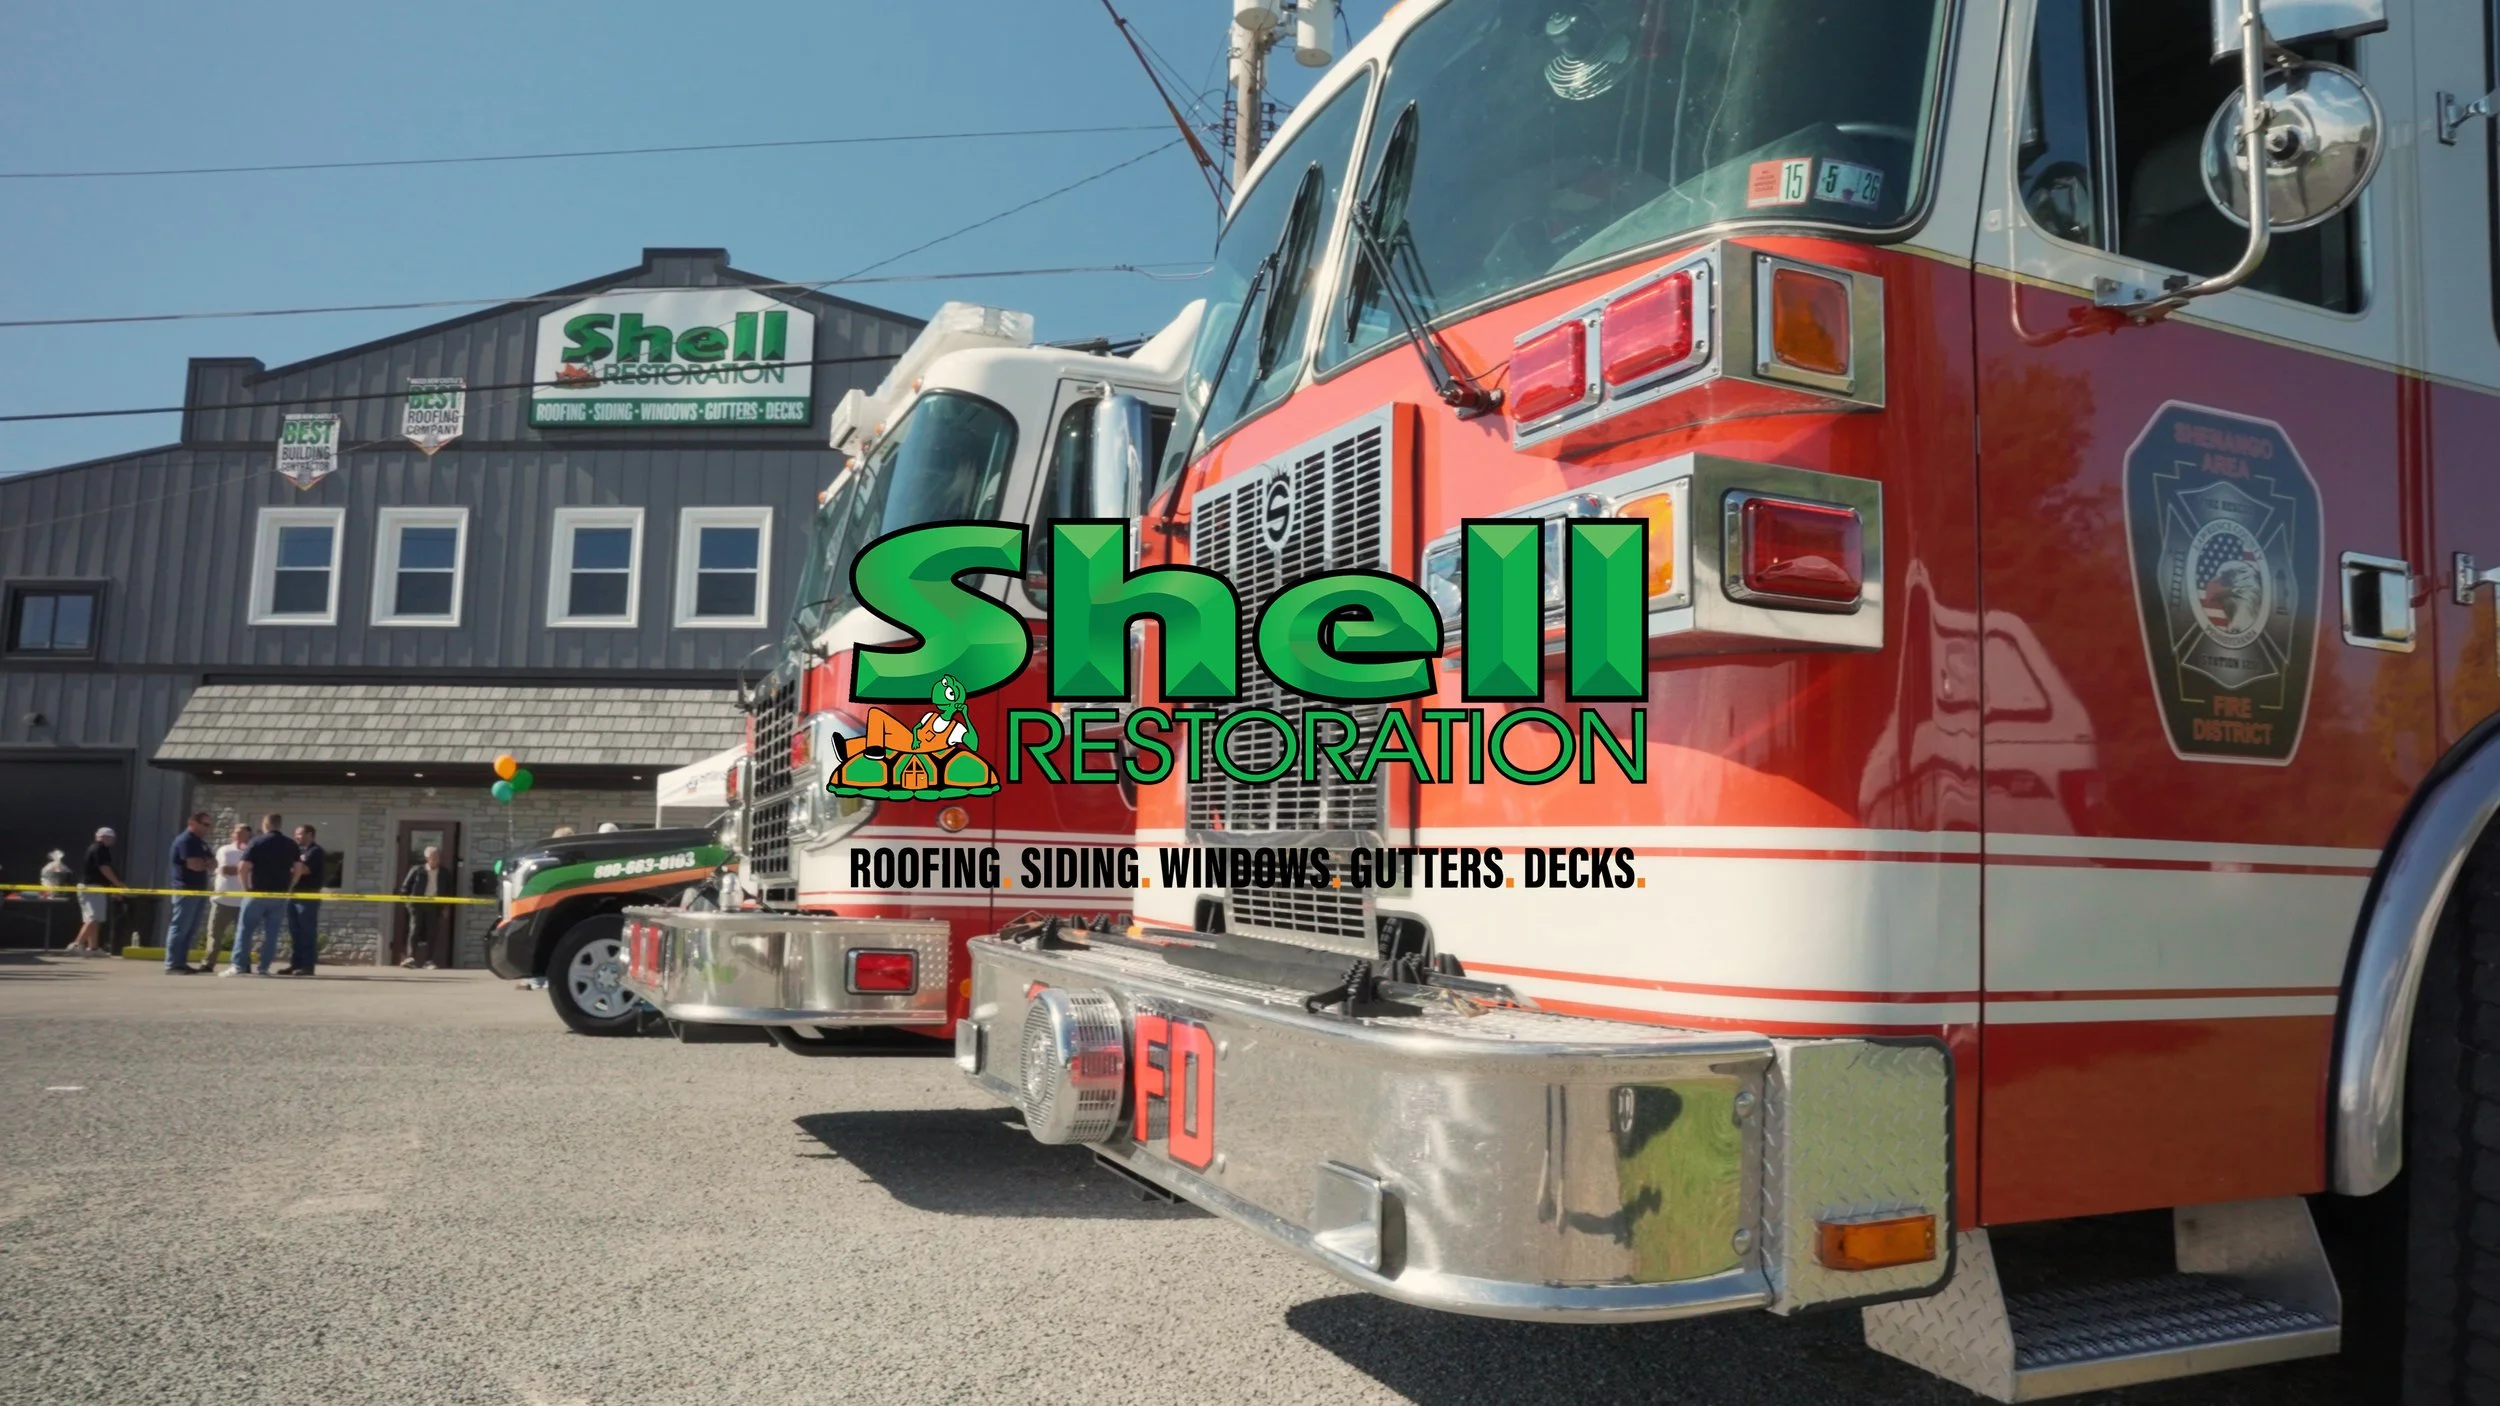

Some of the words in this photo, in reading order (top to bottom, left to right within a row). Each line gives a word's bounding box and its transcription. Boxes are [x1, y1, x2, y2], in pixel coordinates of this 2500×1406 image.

[1784, 163, 1804, 200] 15
[1861, 172, 1880, 202] 26
[561, 310, 788, 364] Shell
[603, 361, 786, 386] RESTORATION
[409, 385, 462, 409] BEST
[407, 410, 460, 423] ROOFING
[535, 402, 587, 422] ROOFING
[593, 402, 634, 422] SIDING
[640, 402, 698, 421] WINDOWS
[704, 401, 758, 421] GUTTERS
[764, 401, 805, 420] DECKS
[282, 420, 336, 445] BEST
[406, 424, 459, 435] COMPANY
[2174, 421, 2274, 460] SHENANGO
[281, 445, 331, 461] BUILDING
[2201, 452, 2250, 480] AREA
[2213, 695, 2252, 719] FIRE
[2193, 717, 2274, 745] DISTRICT
